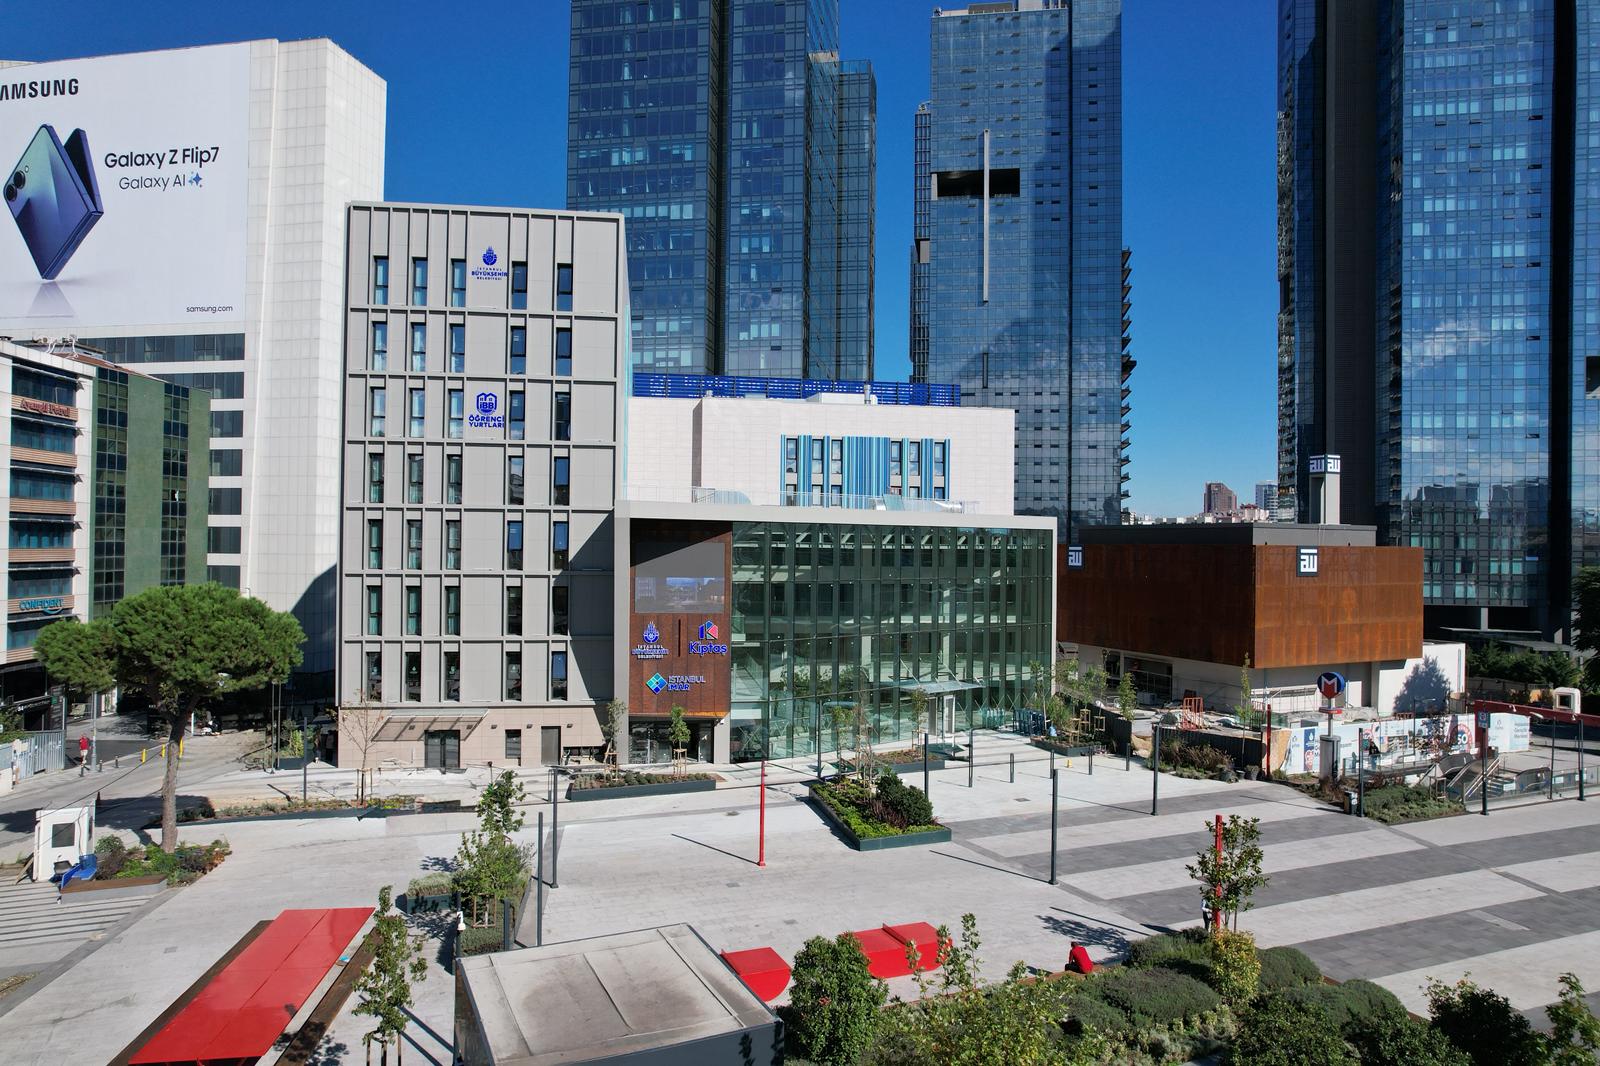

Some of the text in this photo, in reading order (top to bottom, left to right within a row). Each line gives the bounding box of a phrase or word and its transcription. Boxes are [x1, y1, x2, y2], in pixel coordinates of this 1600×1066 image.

[104, 146, 220, 170] Galaxy Z Flip7
[119, 174, 170, 192] Galaxy
[186, 304, 233, 314] samsung.com
[19, 598, 64, 610] CONFIDENT
[689, 641, 728, 656] Kiptaş
